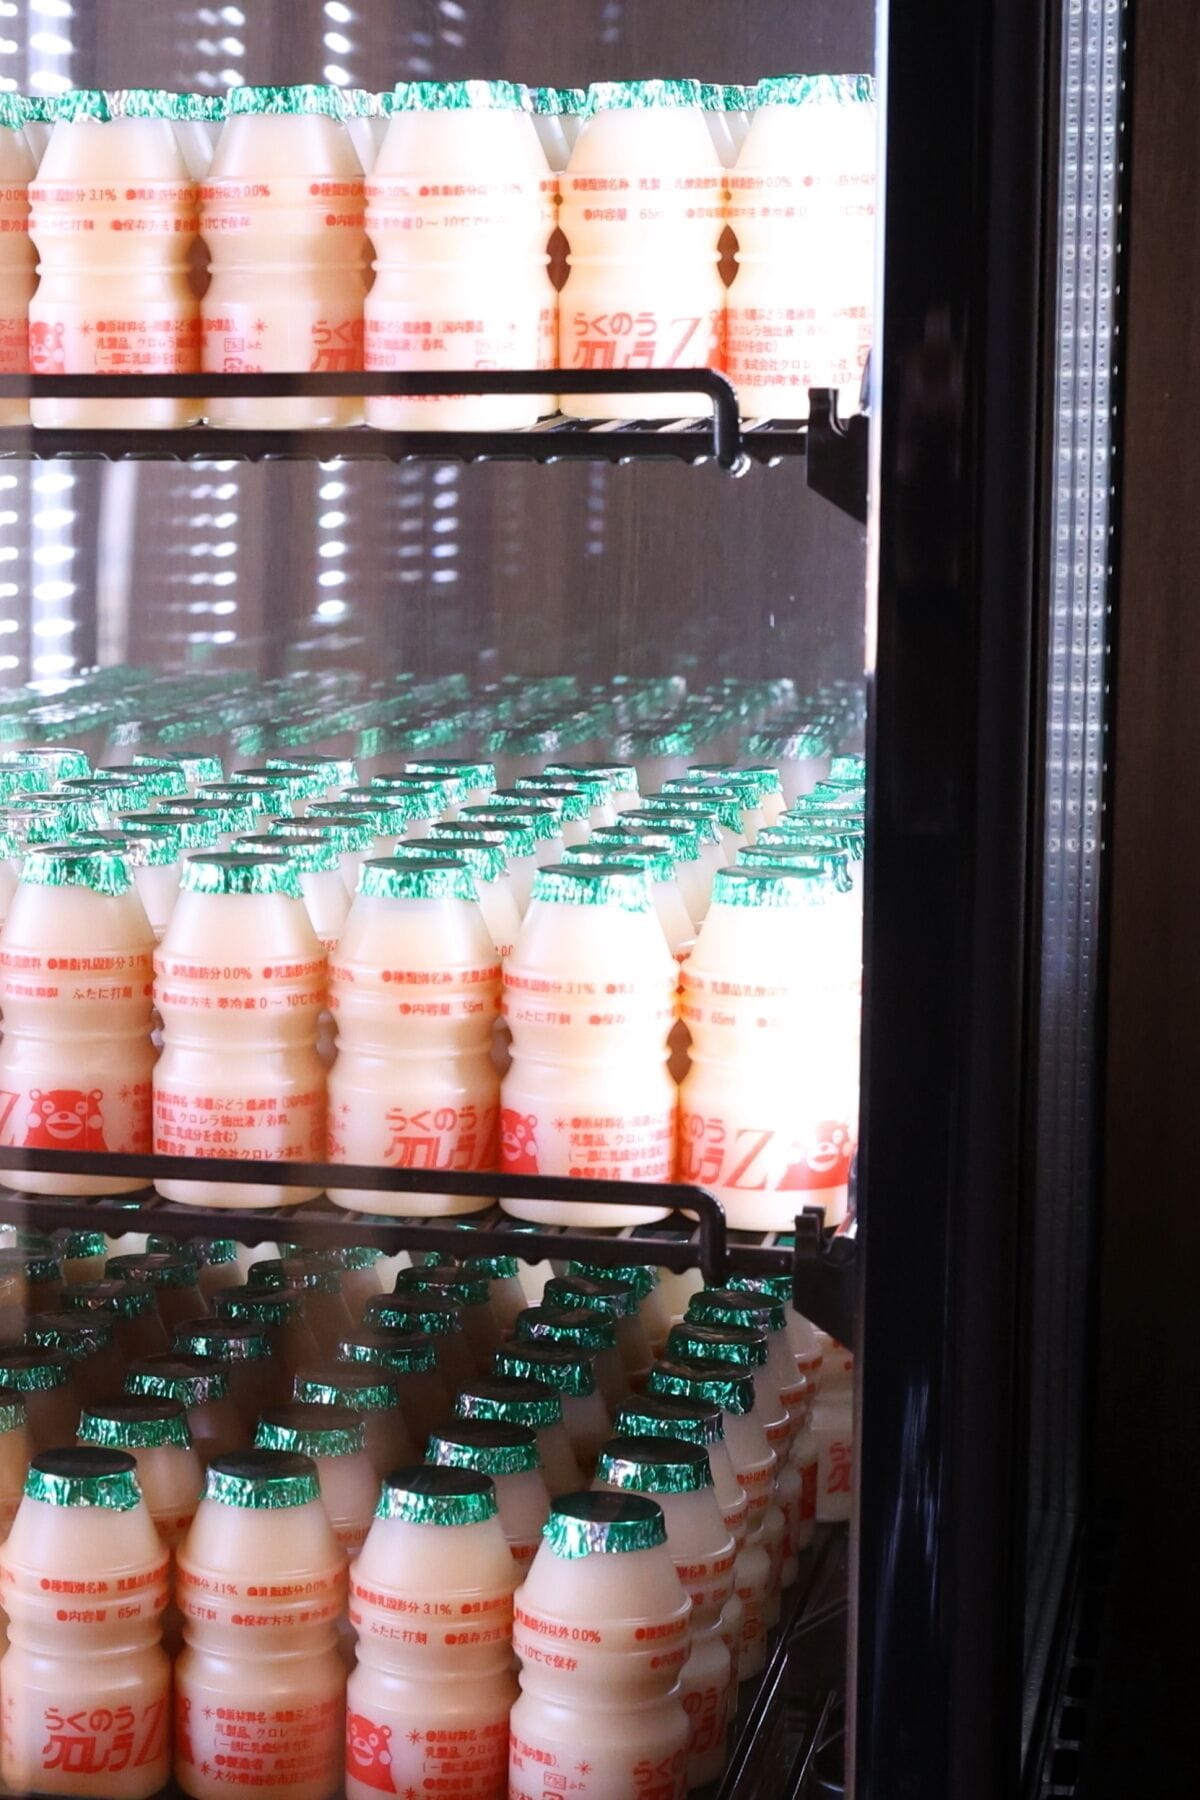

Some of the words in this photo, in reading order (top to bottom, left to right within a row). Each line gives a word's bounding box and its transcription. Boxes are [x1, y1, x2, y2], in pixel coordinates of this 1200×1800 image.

[573, 312, 657, 337] らくのう
[385, 1105, 478, 1132] らくのう
[723, 1127, 775, 1192] Z
[50, 1580, 108, 1594] 種類別名称
[68, 1609, 107, 1623] 内容量
[118, 1604, 142, 1619] 65ml
[422, 1603, 453, 1614] 3.1%
[244, 1614, 295, 1627] 保存方法
[370, 1622, 428, 1645] ふたに打刻
[572, 1628, 602, 1643] 0.0%
[44, 1706, 135, 1732] らくのう
[42, 1732, 135, 1773] クロレラ
